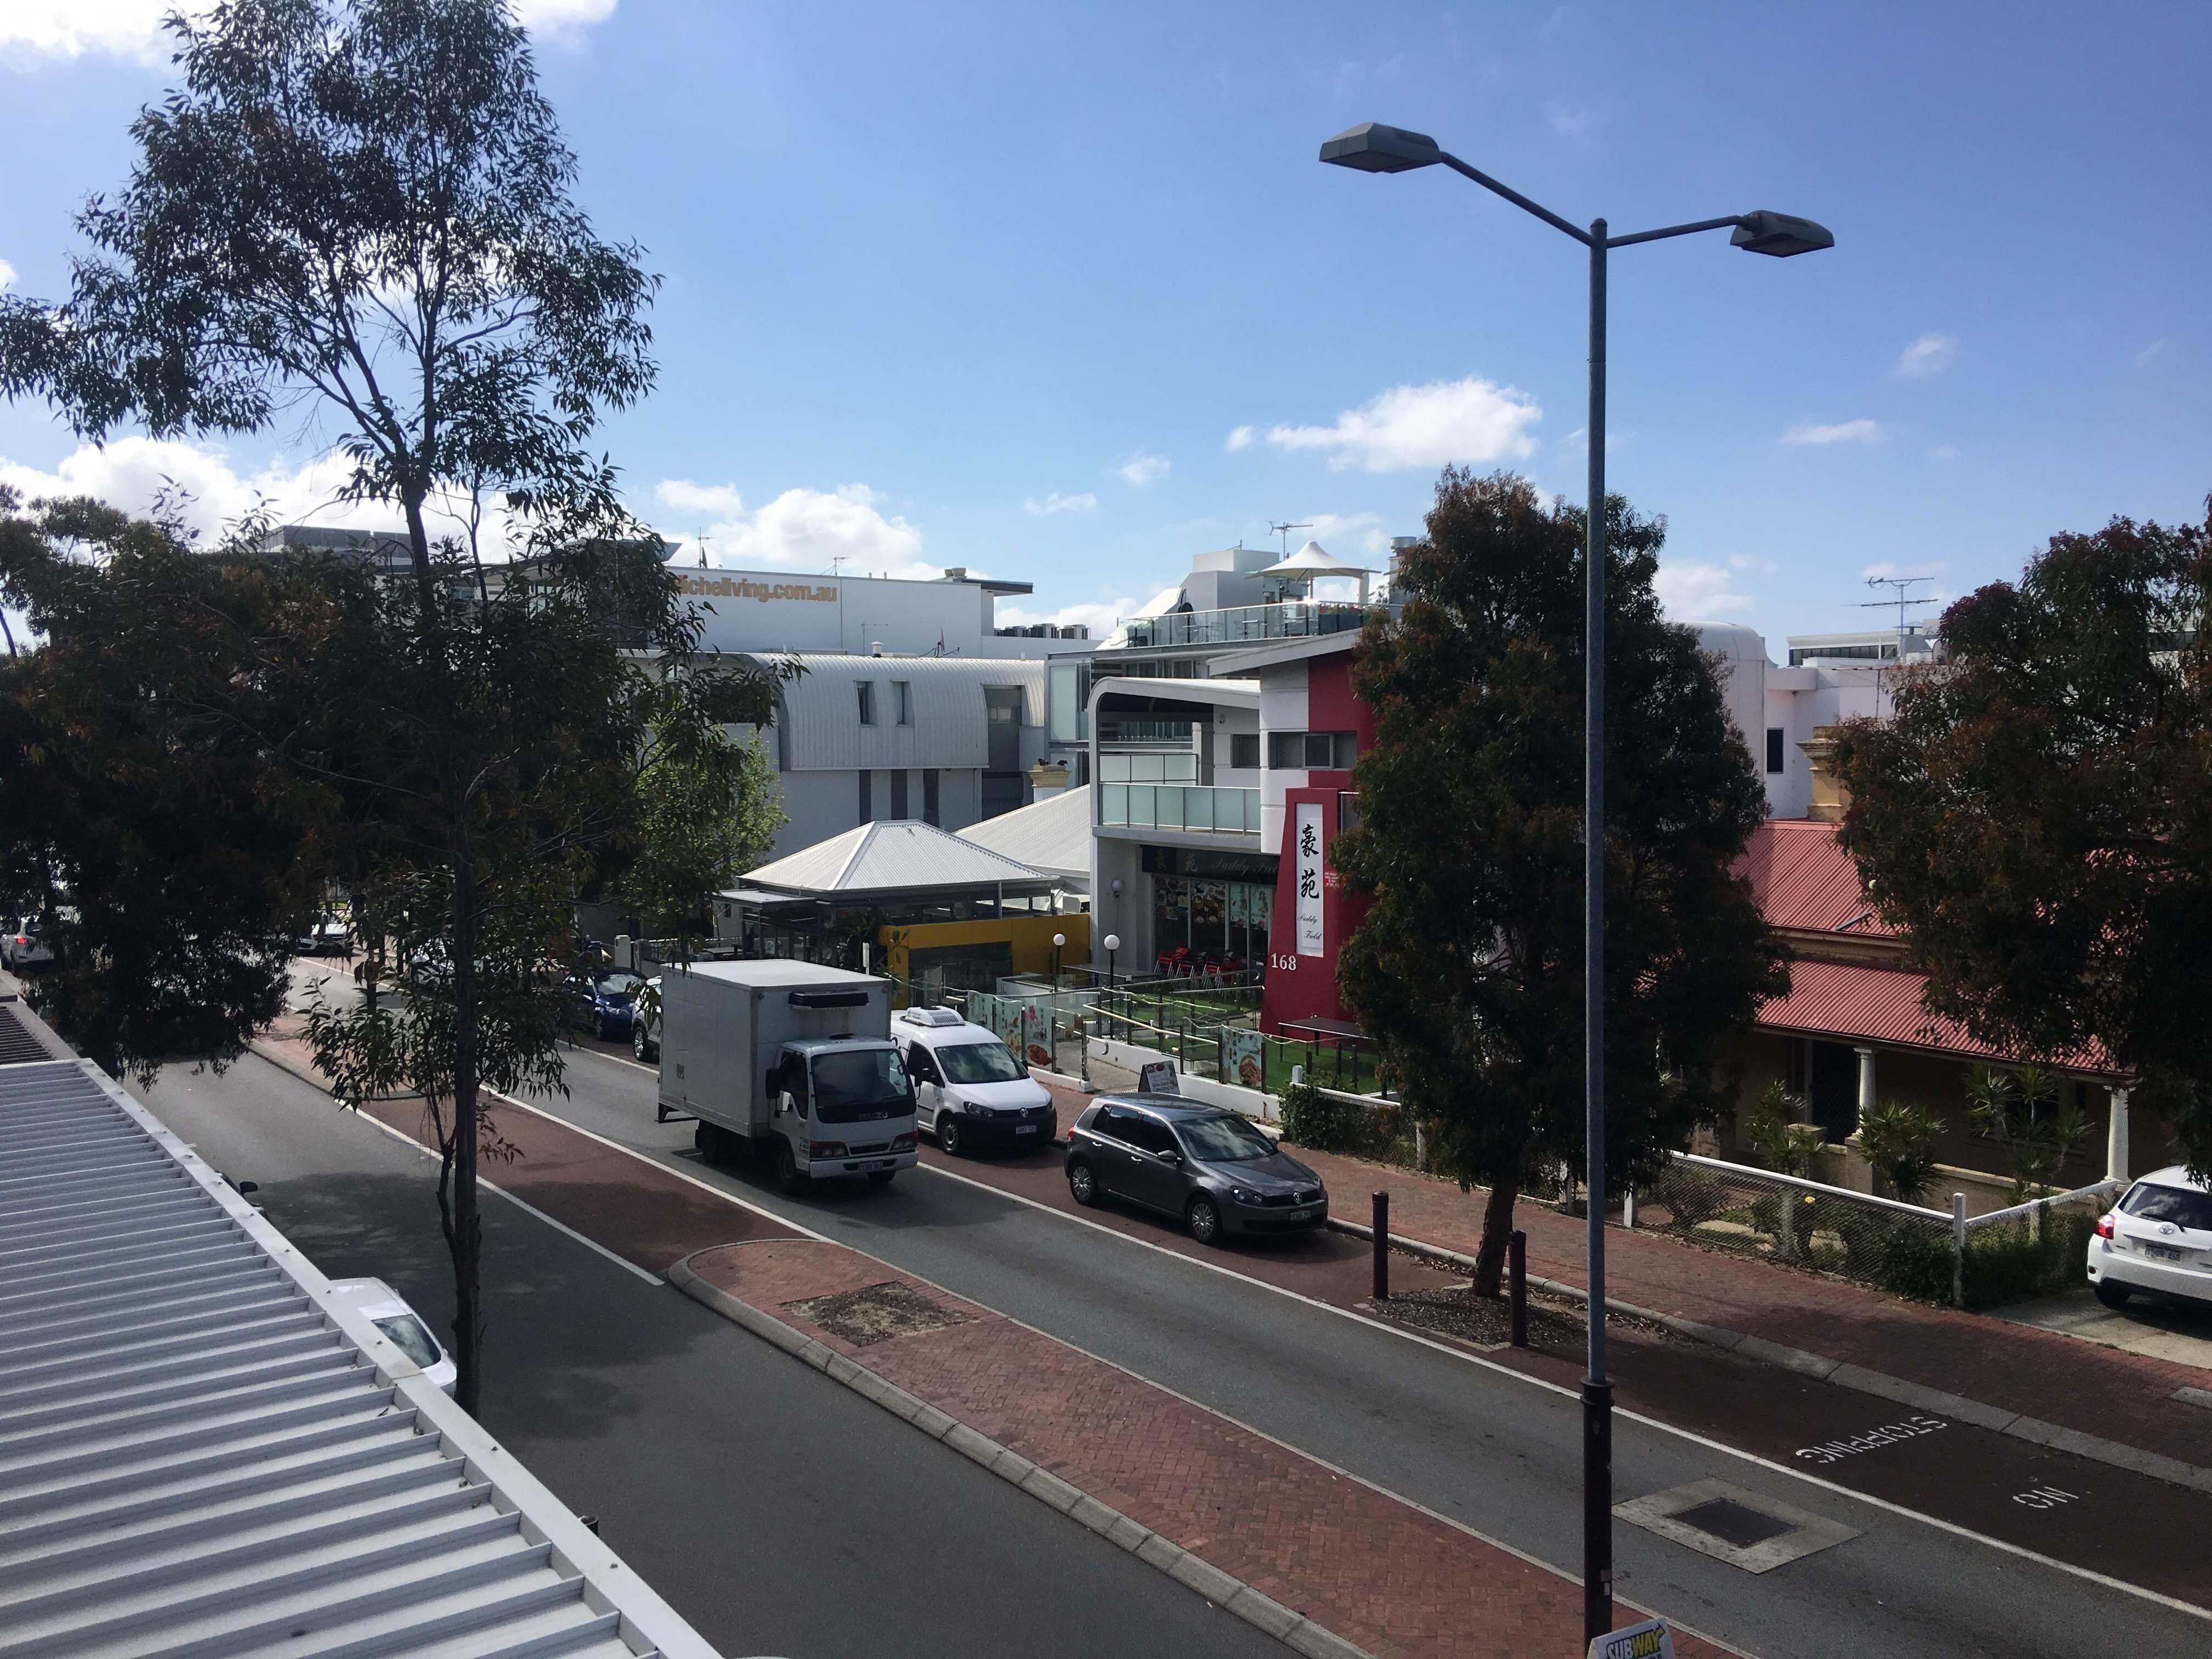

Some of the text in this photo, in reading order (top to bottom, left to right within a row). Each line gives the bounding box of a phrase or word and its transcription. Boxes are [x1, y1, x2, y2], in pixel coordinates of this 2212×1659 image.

[675, 575, 838, 603] icheliving.com.au
[1271, 953, 1296, 970] 168
[858, 1111, 888, 1119] ISUZU
[1796, 1416, 1947, 1463] STOPPING
[2013, 1486, 2080, 1508] NO
[1607, 1623, 1665, 1659] SUBWAY
